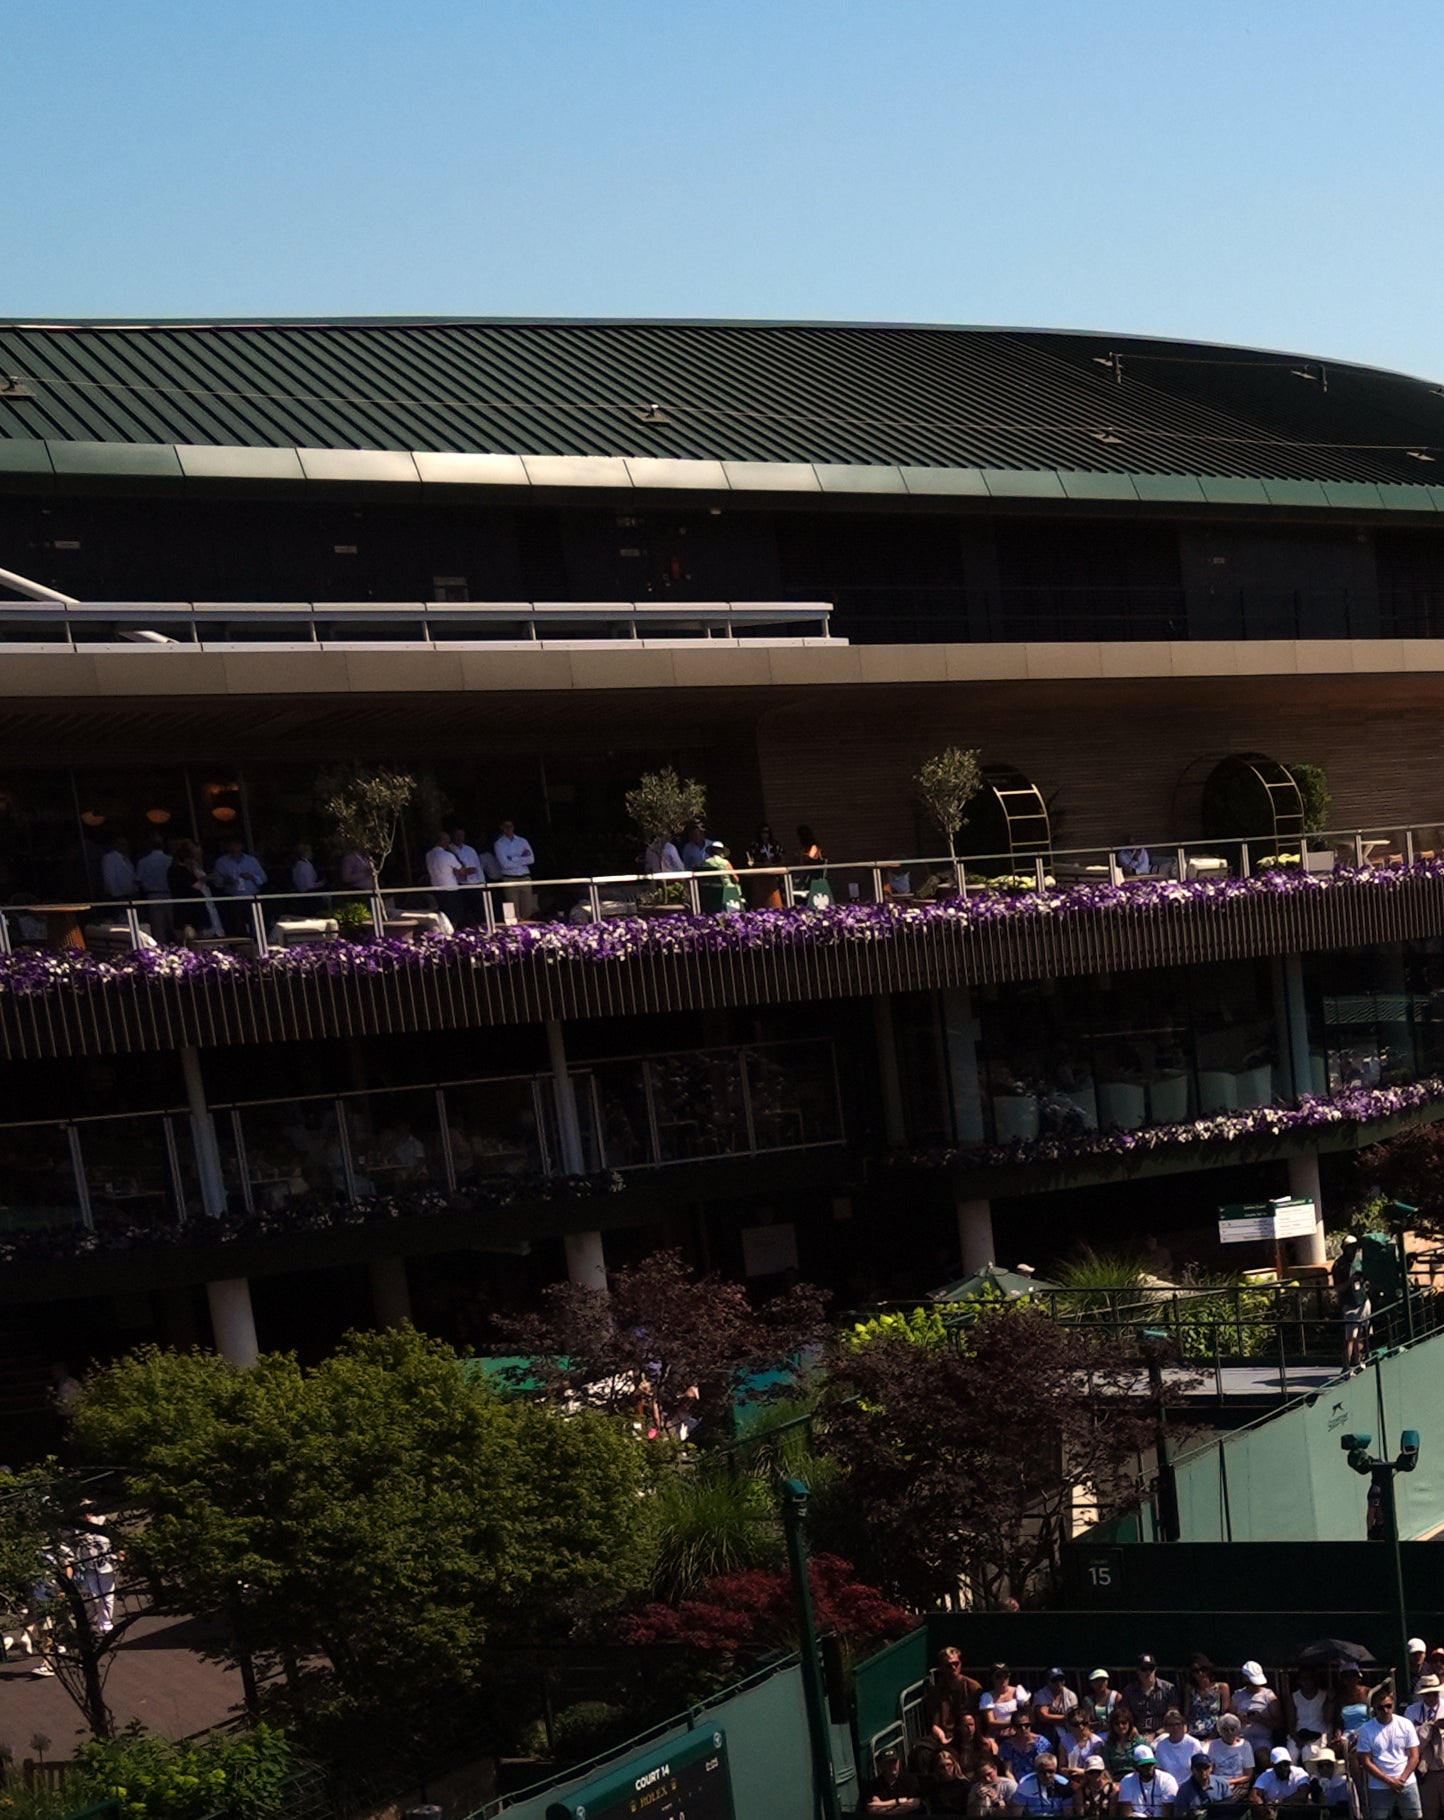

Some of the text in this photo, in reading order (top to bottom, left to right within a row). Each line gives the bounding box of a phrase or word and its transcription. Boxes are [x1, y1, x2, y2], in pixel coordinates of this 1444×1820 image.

[1088, 1567, 1112, 1585] 15
[635, 1763, 671, 1791] COURT 14
[640, 1787, 669, 1809] ROLEX
